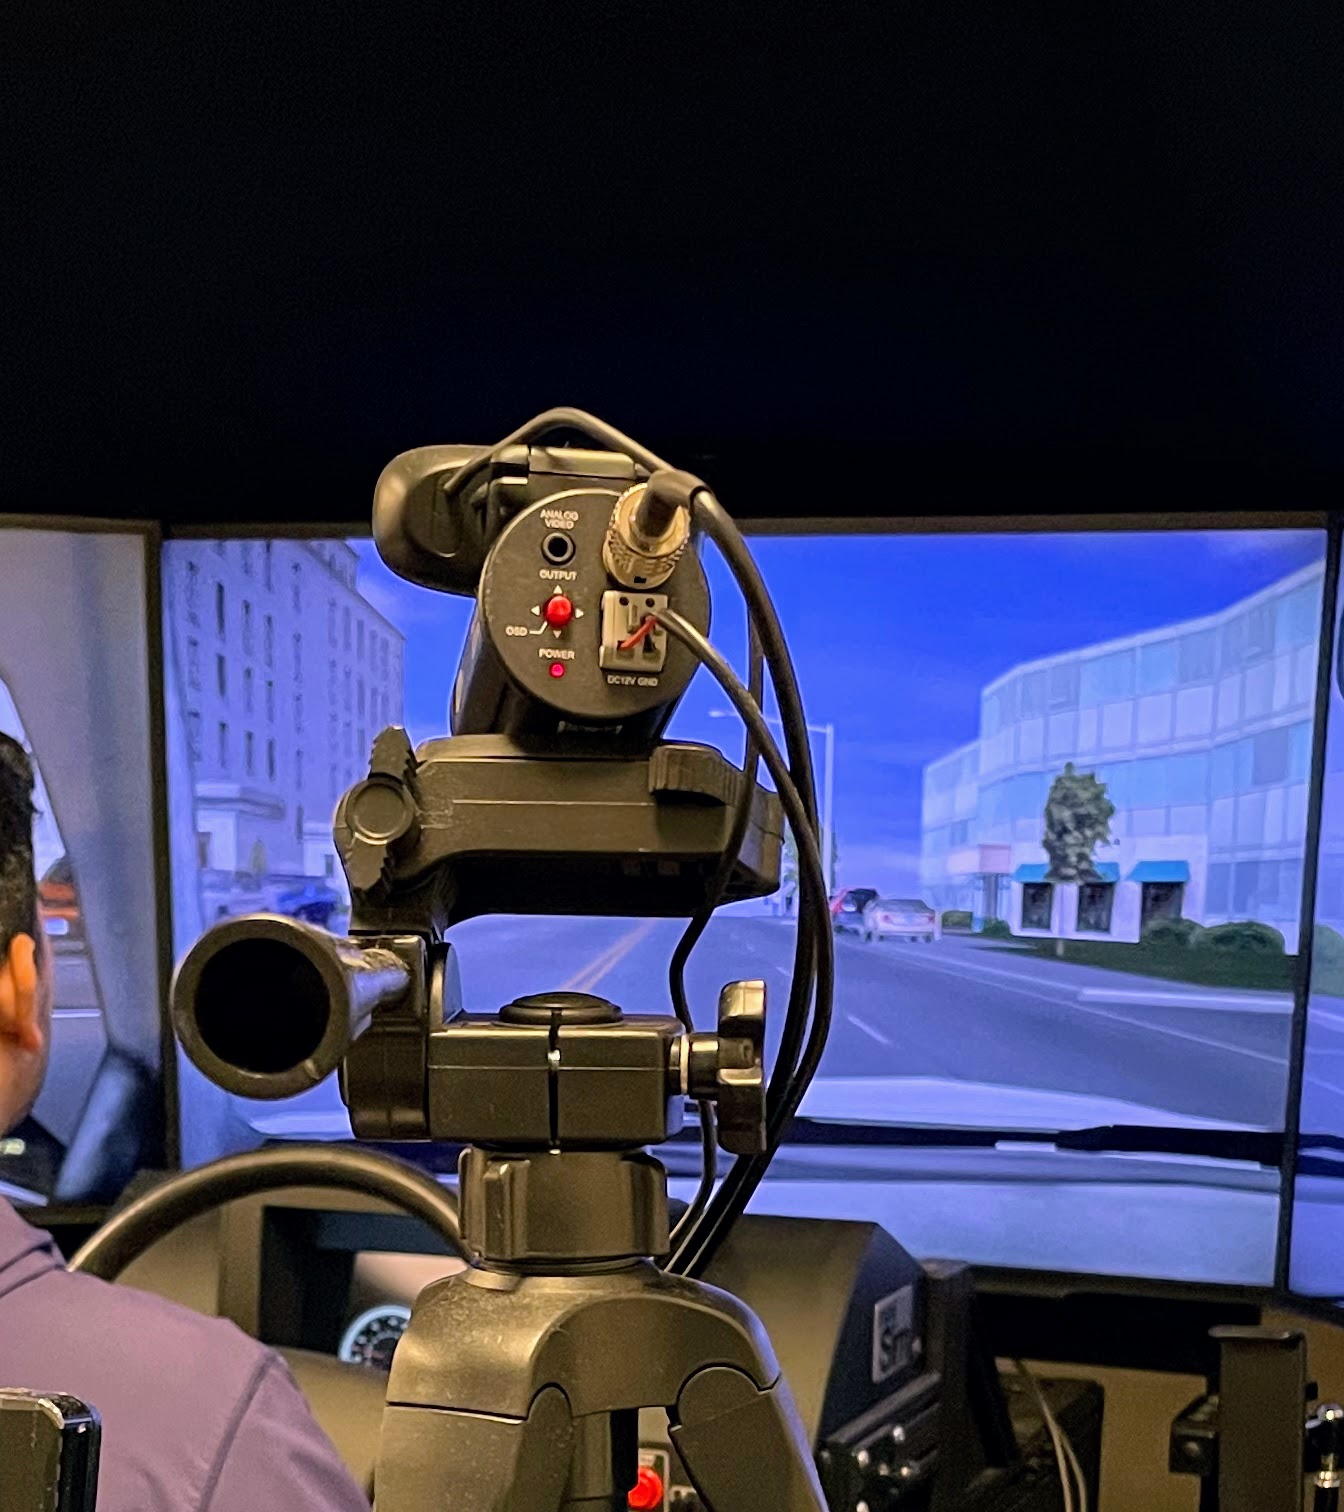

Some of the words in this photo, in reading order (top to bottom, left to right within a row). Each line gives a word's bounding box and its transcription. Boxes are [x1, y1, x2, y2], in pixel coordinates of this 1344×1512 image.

[540, 509, 579, 522] ANALOG
[544, 519, 574, 530] VIDEO
[539, 570, 577, 581] OUTPUT
[506, 626, 528, 636] OSD
[539, 648, 575, 660] POWER
[638, 677, 658, 687] GND
